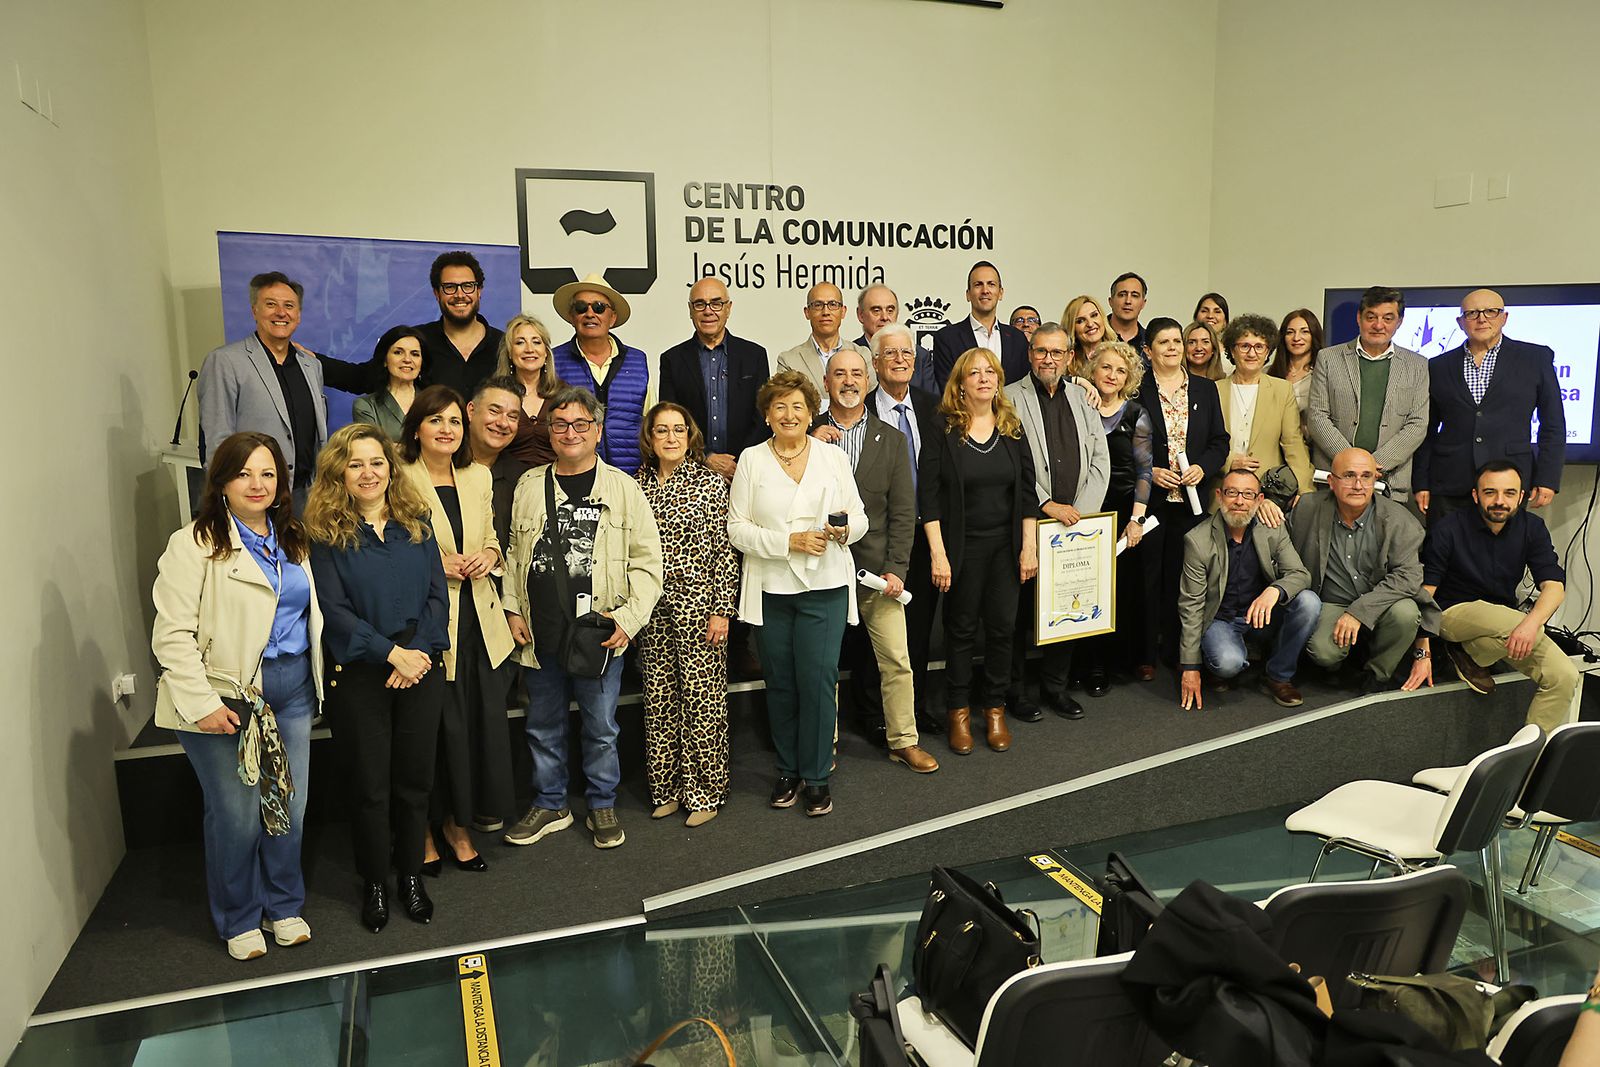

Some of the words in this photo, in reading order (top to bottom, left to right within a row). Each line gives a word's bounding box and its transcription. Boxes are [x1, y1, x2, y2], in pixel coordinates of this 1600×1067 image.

[683, 181, 805, 212] CENTRO
[685, 216, 725, 243] DE
[734, 218, 775, 244] LA
[782, 218, 994, 250] COMUNICACIÓN
[686, 252, 765, 289] Jesús
[776, 253, 885, 290] Hermida
[1062, 561, 1090, 569] DIPLOMA
[470, 982, 484, 1018] MANTENGA
[475, 1018, 485, 1028] LA
[475, 1027, 490, 1064] DISTANCIA
